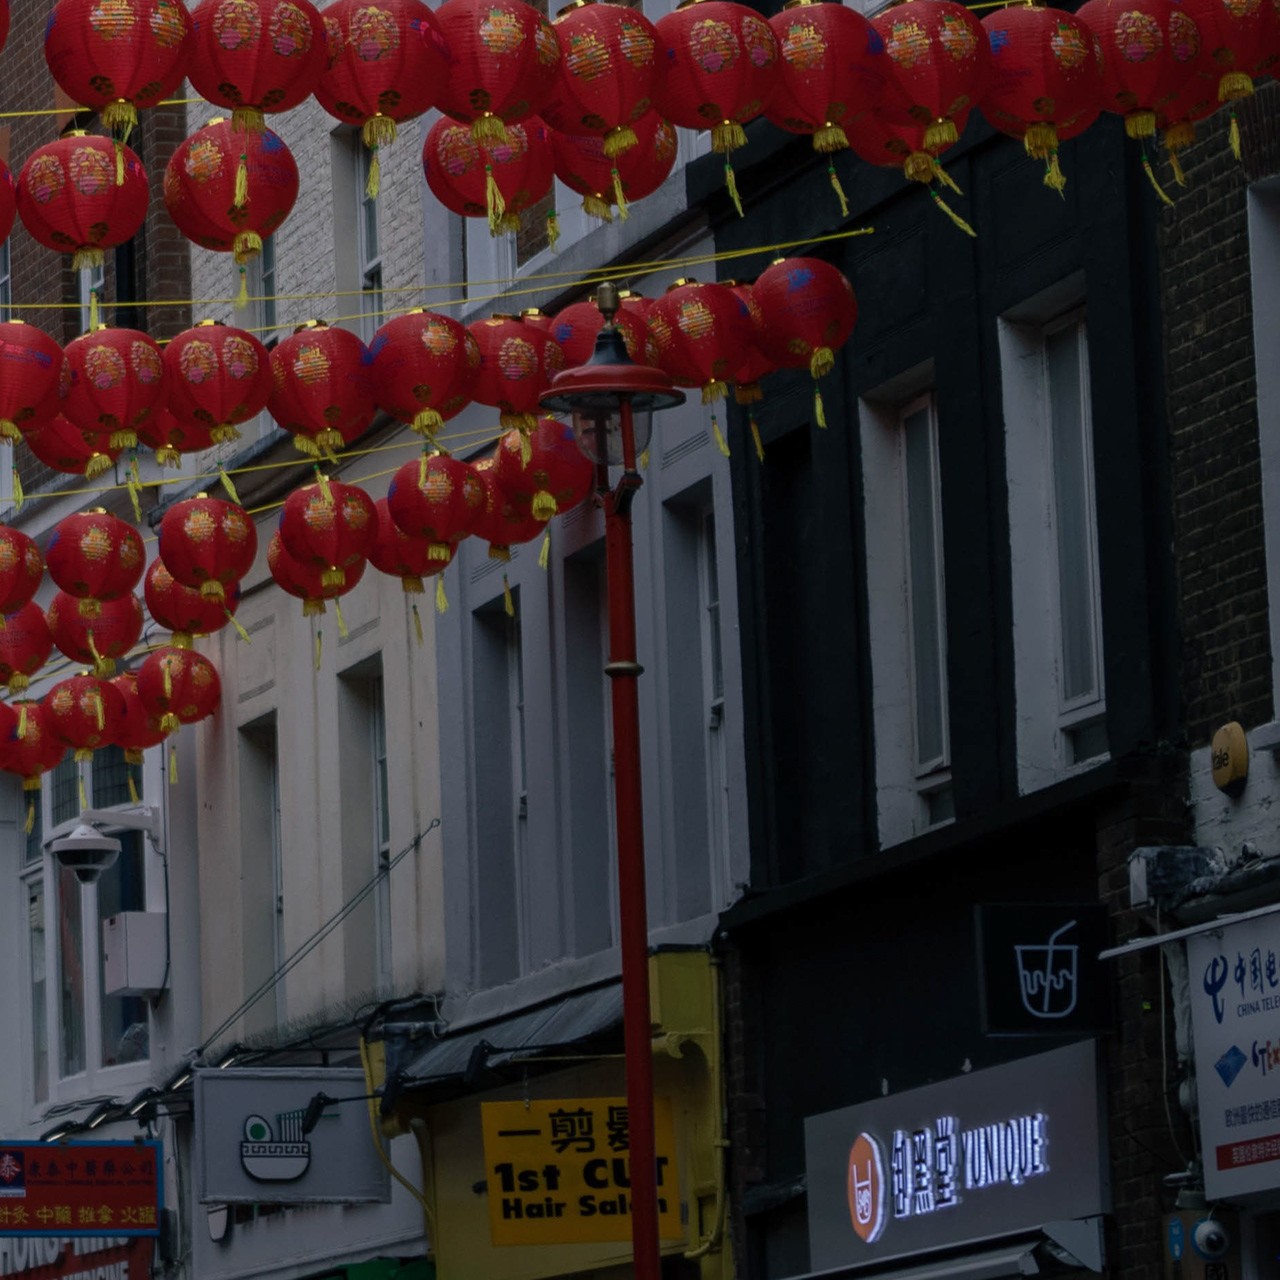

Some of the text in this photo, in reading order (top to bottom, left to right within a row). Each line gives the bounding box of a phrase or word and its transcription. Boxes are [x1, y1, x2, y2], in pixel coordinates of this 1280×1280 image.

[1236, 1000, 1261, 1018] CHINA
[961, 1113, 1050, 1189] YUNIQUE
[494, 1162, 561, 1193] 1st
[502, 1194, 668, 1219] Hair Saln
